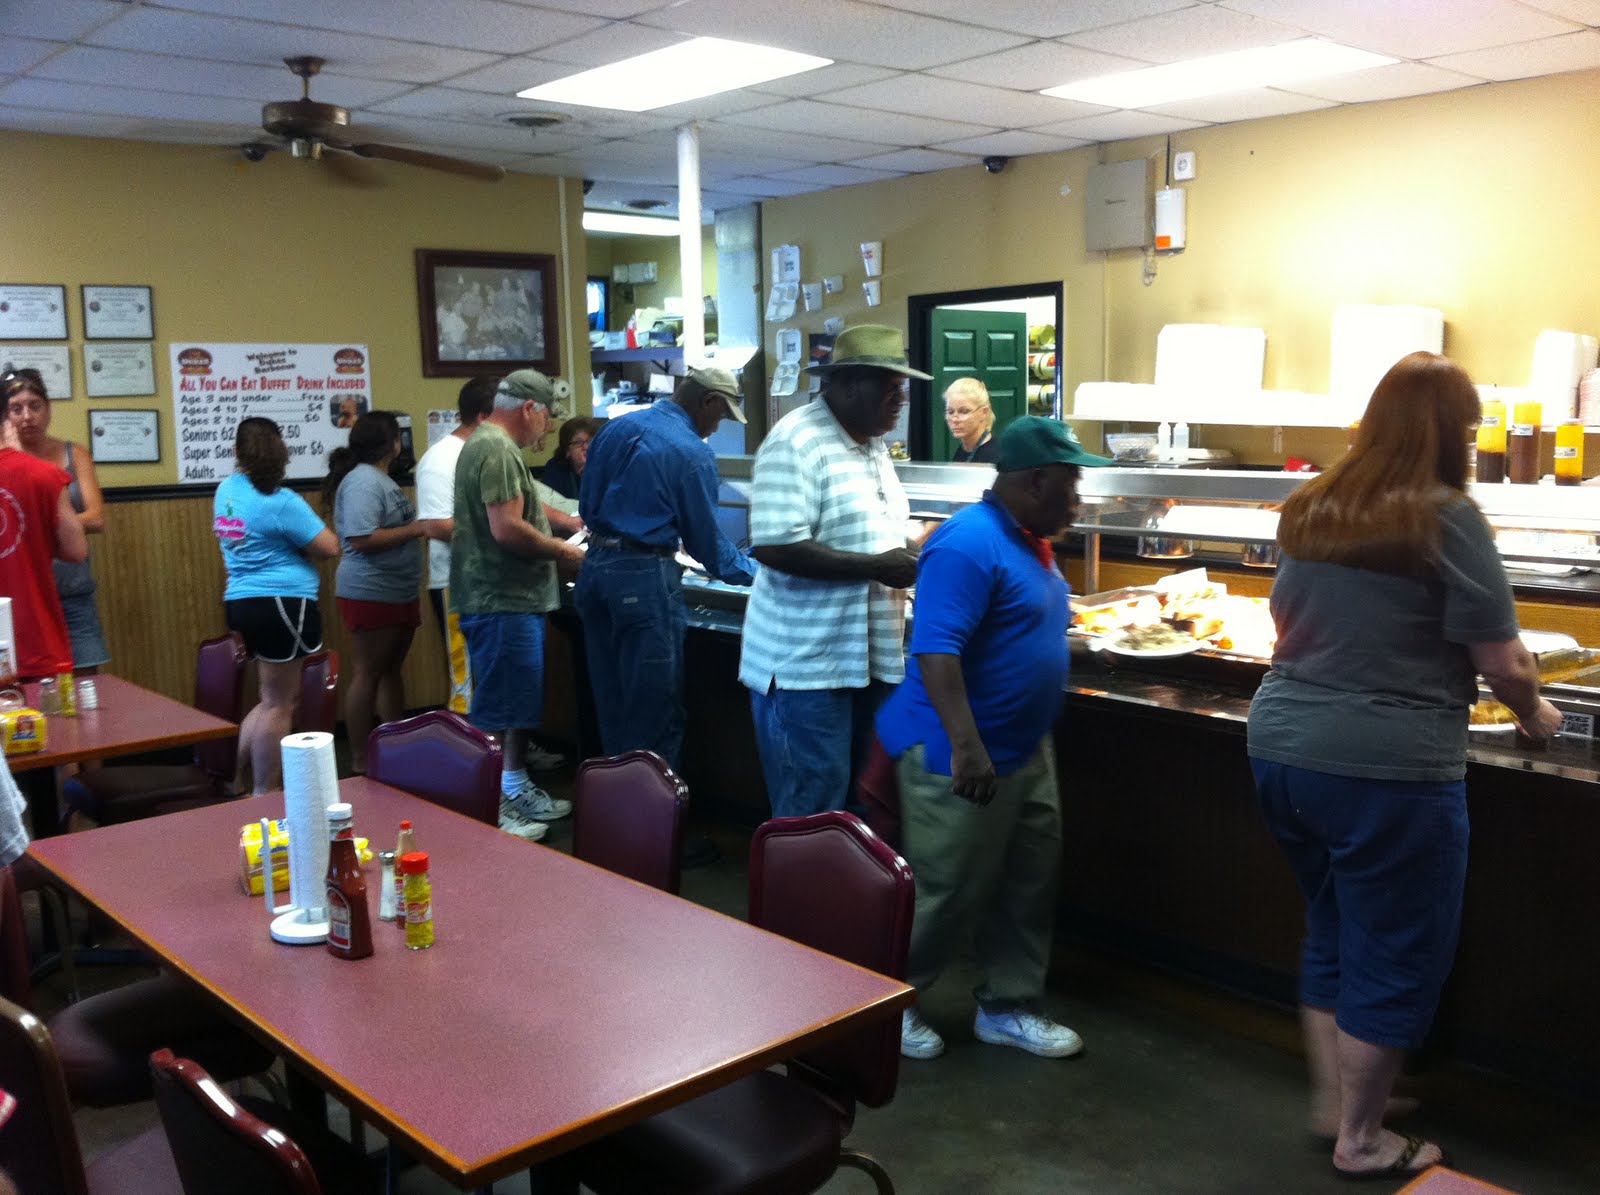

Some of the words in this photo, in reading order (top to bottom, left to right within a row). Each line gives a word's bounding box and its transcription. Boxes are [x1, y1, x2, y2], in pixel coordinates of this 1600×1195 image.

[181, 395, 201, 405] Age
[218, 394, 238, 403] and
[241, 394, 273, 402] under
[181, 405, 208, 416] Ages
[212, 405, 221, 413] 4
[226, 405, 237, 413] to
[181, 416, 210, 426] Ages
[225, 416, 237, 424] to
[182, 427, 218, 442] Seniors
[220, 427, 236, 441] 62
[183, 446, 211, 462] Super
[288, 444, 307, 456] over
[185, 464, 215, 480] Adults
